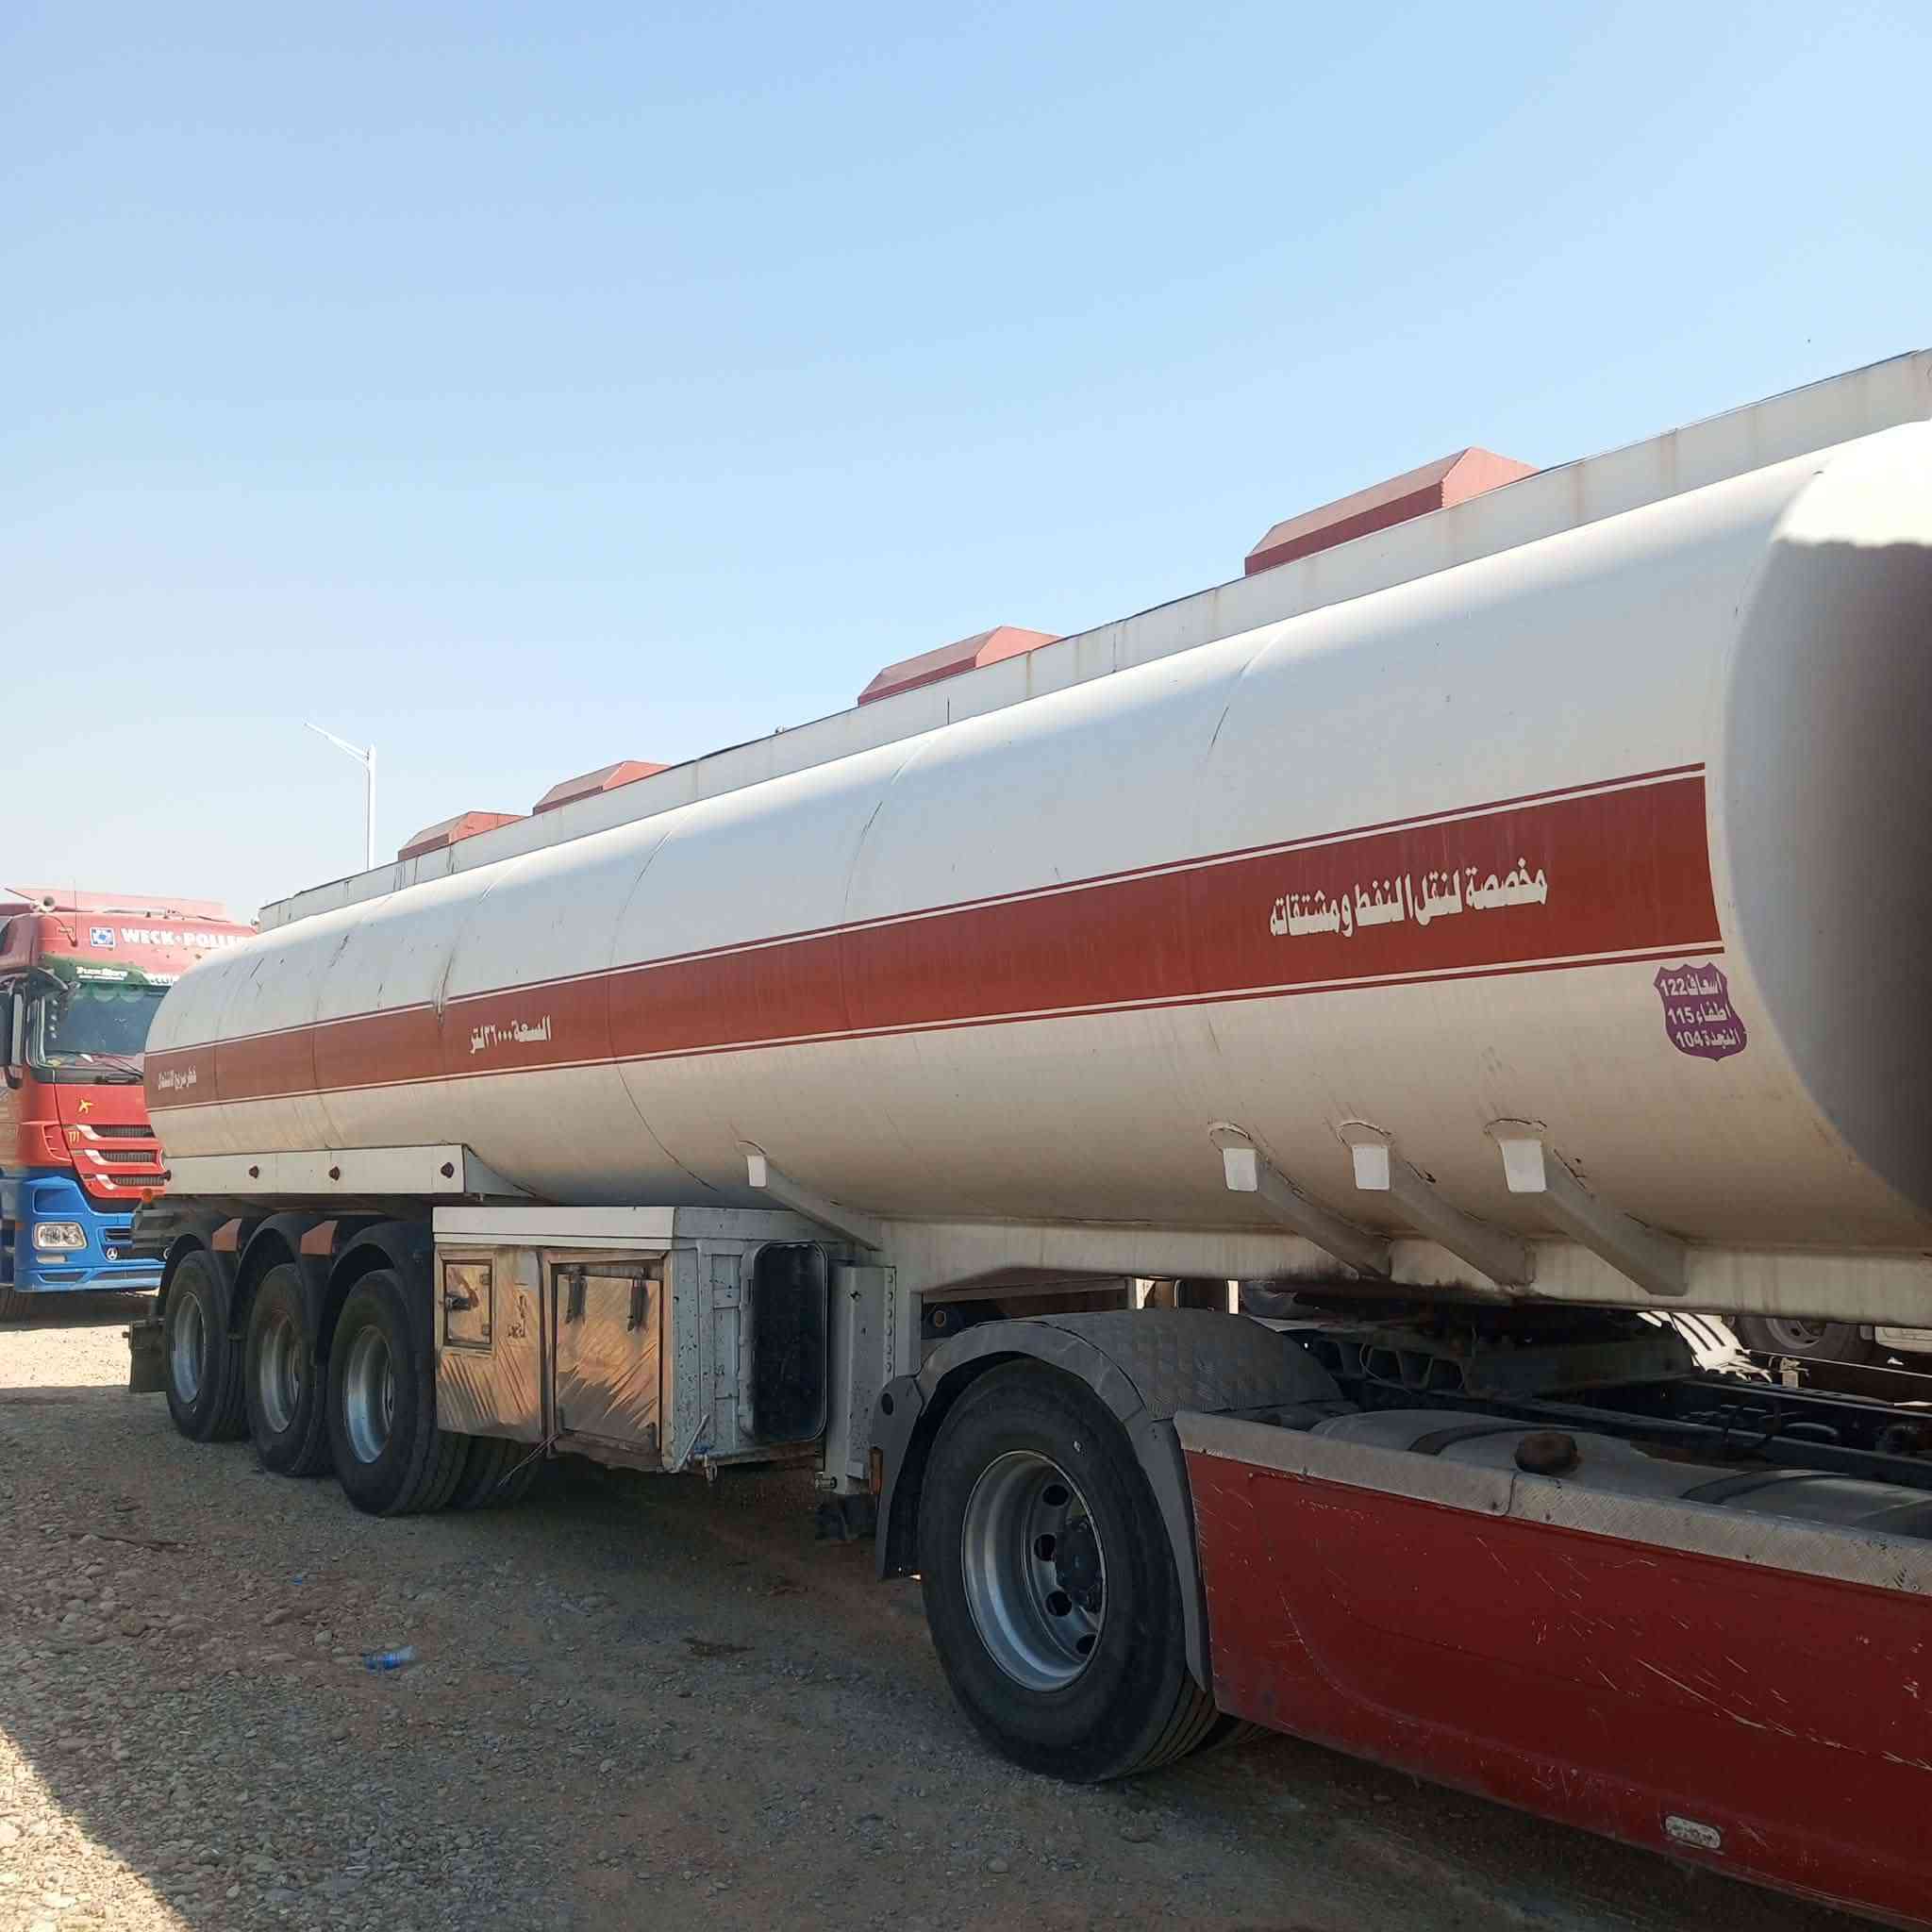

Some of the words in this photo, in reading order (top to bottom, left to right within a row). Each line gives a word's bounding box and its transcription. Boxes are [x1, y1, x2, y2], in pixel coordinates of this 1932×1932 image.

[1354, 873, 1414, 926] النفط
[1414, 869, 1463, 926] لنقل
[1465, 857, 1548, 910] مخصصة
[1659, 977, 1687, 997] 122
[1668, 1006, 1696, 1025] 115
[1675, 1030, 1705, 1049] 104
